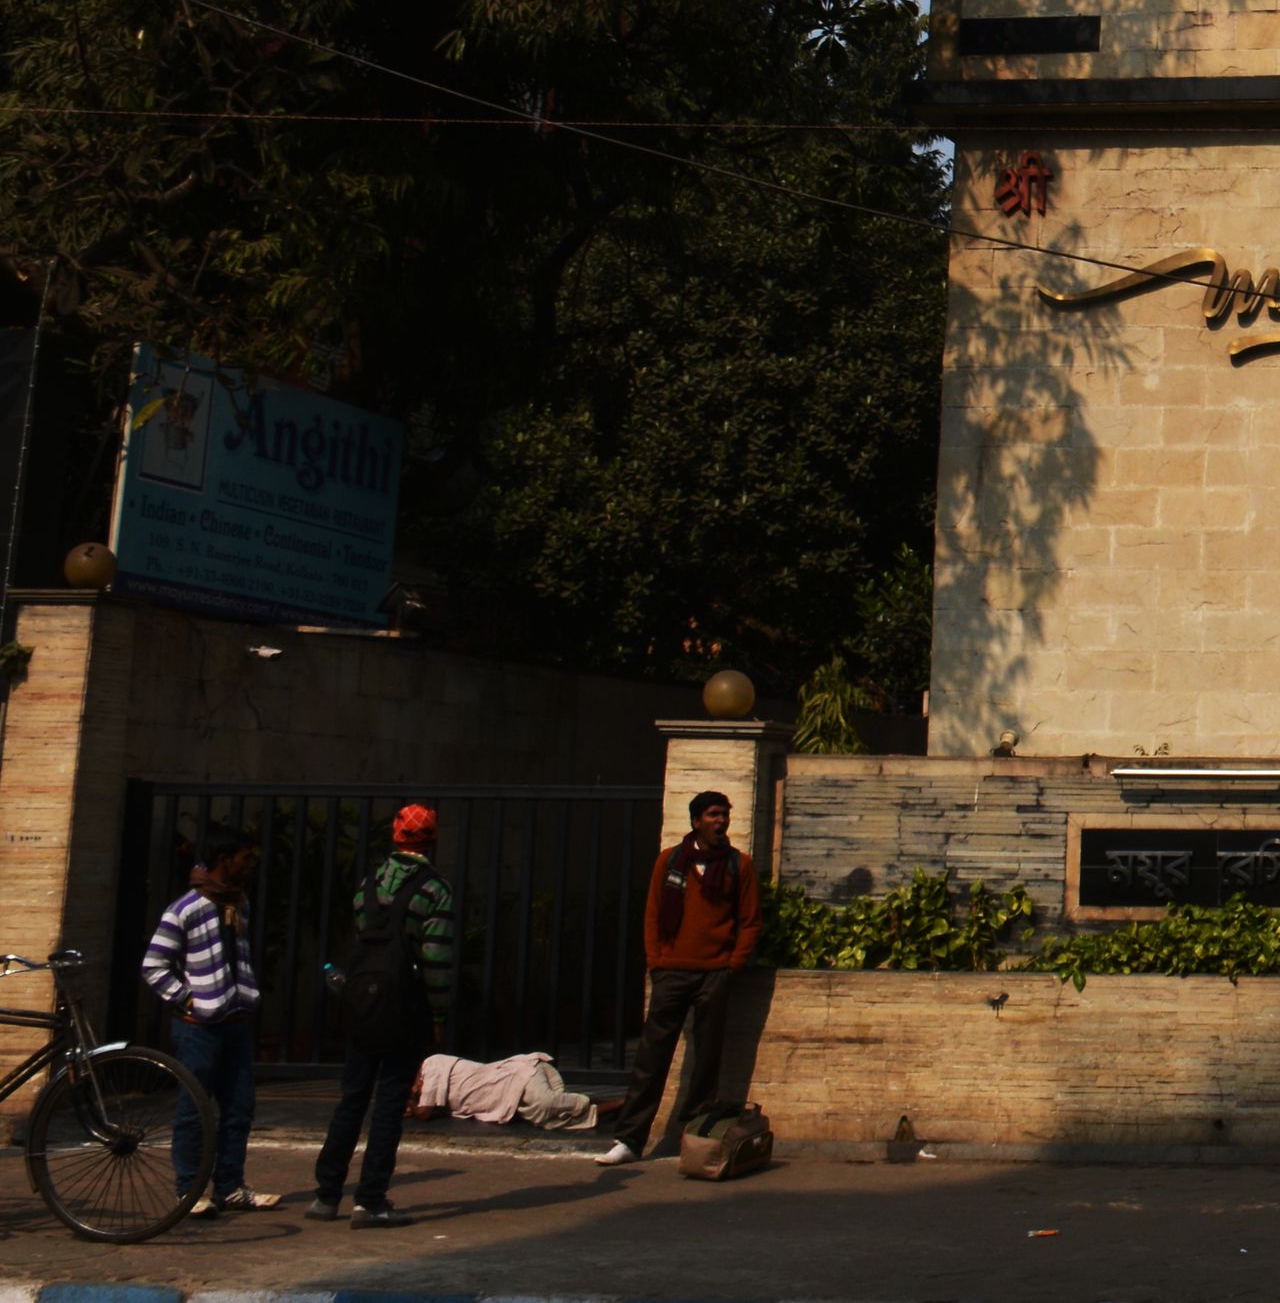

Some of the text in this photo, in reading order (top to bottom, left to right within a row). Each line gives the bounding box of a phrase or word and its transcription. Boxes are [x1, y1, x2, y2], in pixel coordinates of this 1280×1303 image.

[994, 150, 1054, 218] श्री
[224, 391, 393, 495] Angithi
[140, 494, 186, 527] Indian
[200, 508, 251, 542] Chinese
[263, 523, 332, 562] Continental
